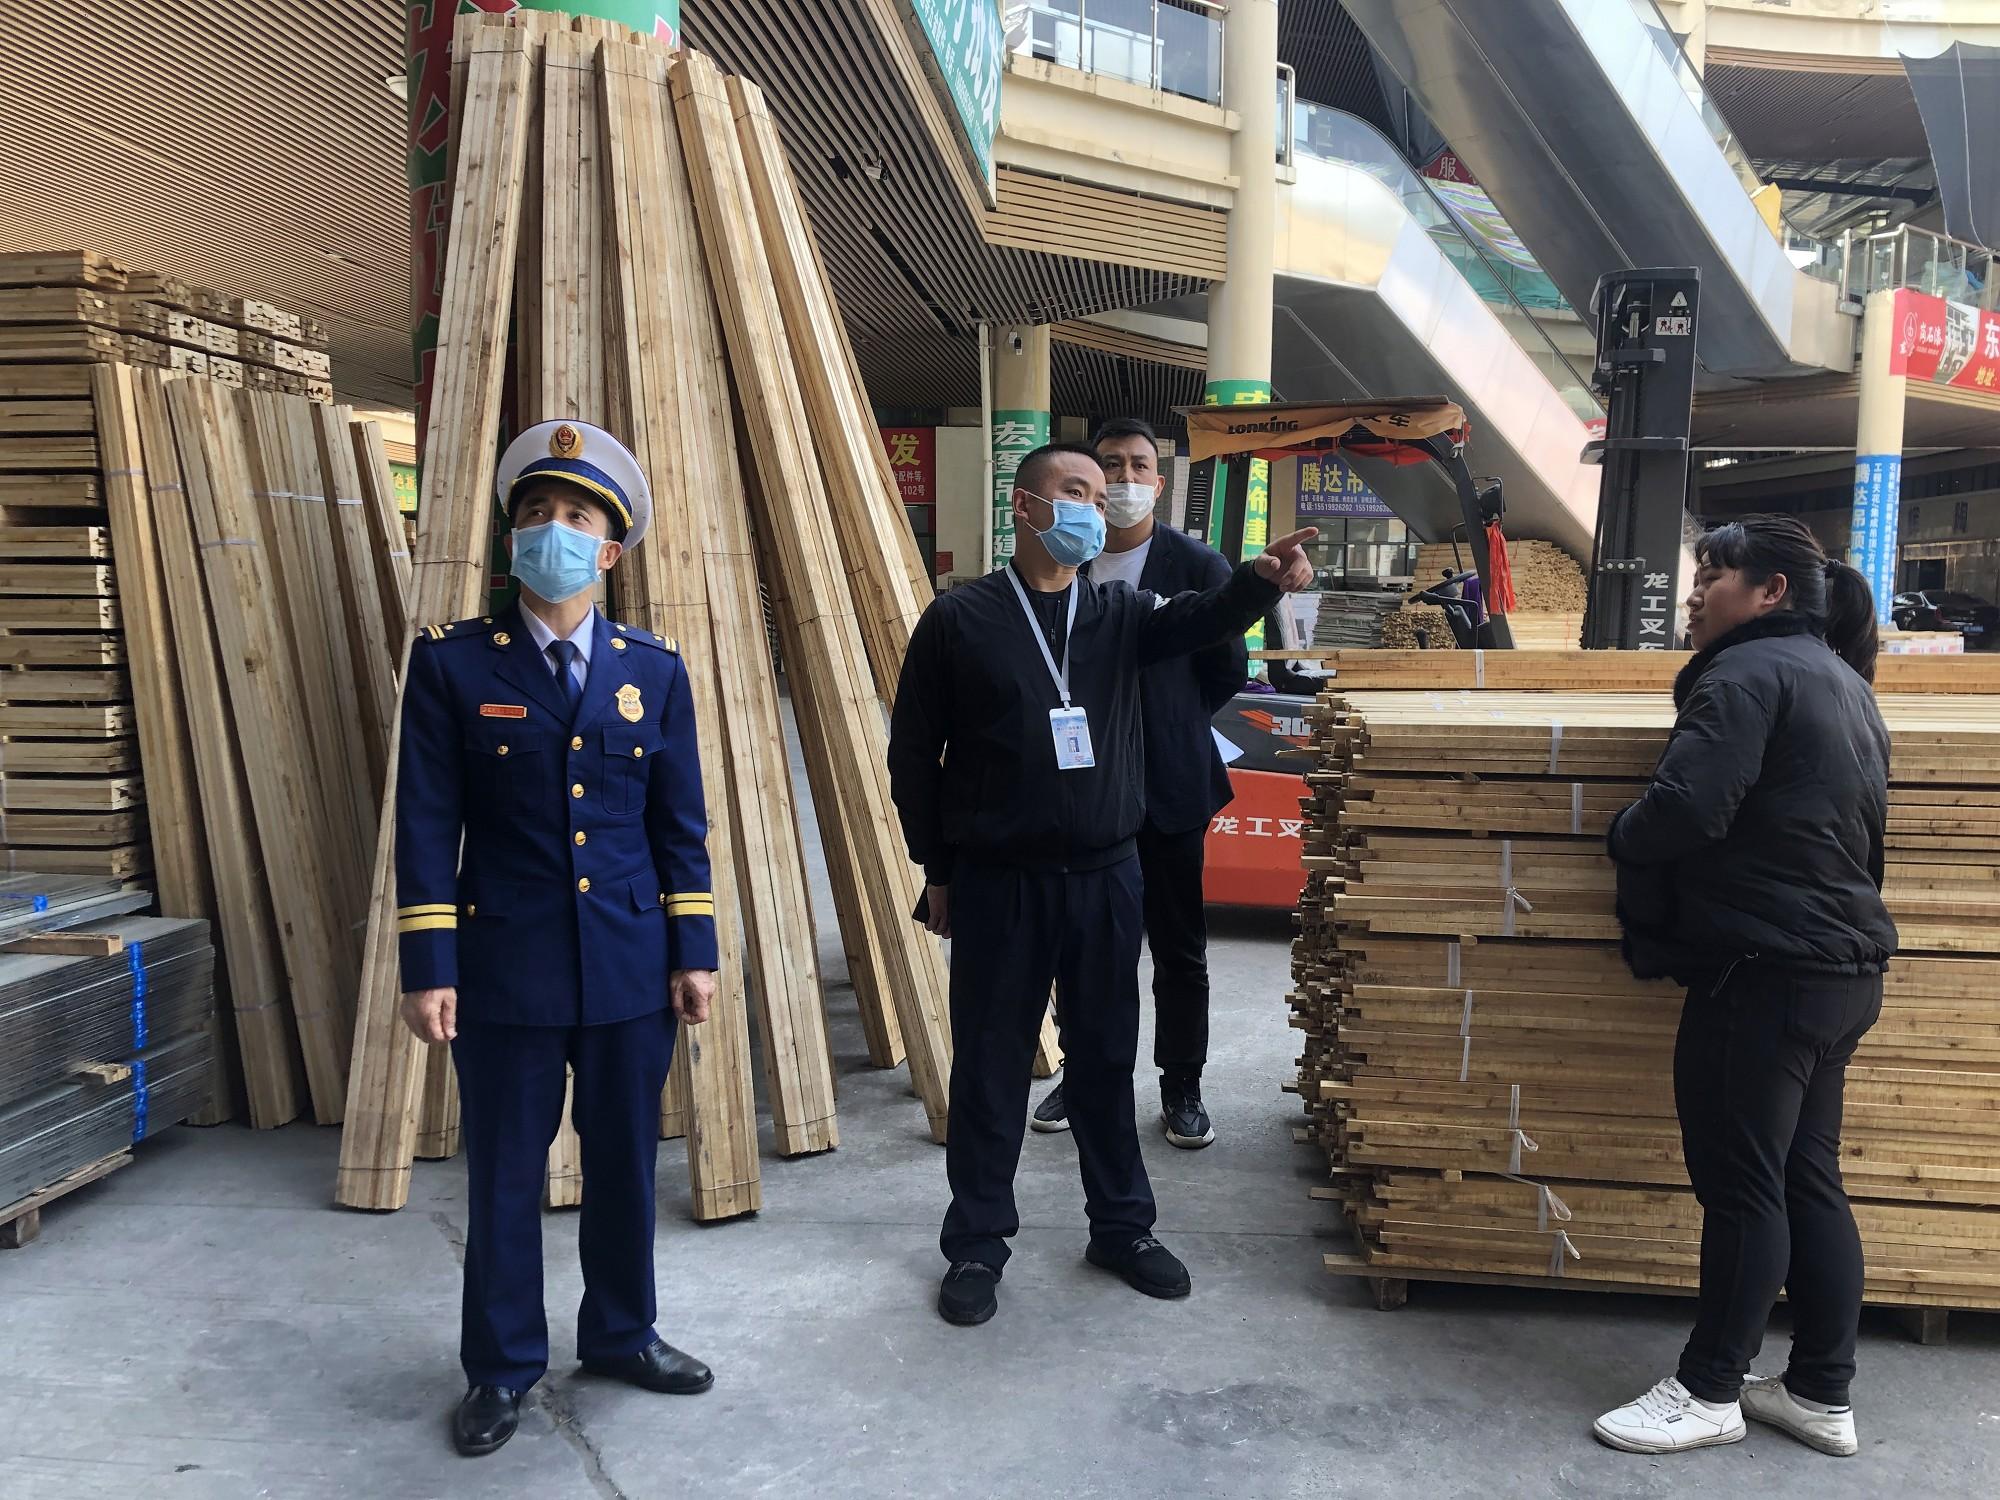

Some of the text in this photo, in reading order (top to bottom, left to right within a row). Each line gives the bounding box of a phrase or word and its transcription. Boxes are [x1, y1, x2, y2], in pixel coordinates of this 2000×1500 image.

[890, 433, 921, 466] 发
[1301, 462, 1373, 494] 腾达吊
[993, 420, 1036, 572] 宏图吊顶建
[1271, 716, 1311, 737] 30
[1212, 815, 1304, 839] 龙工叉
